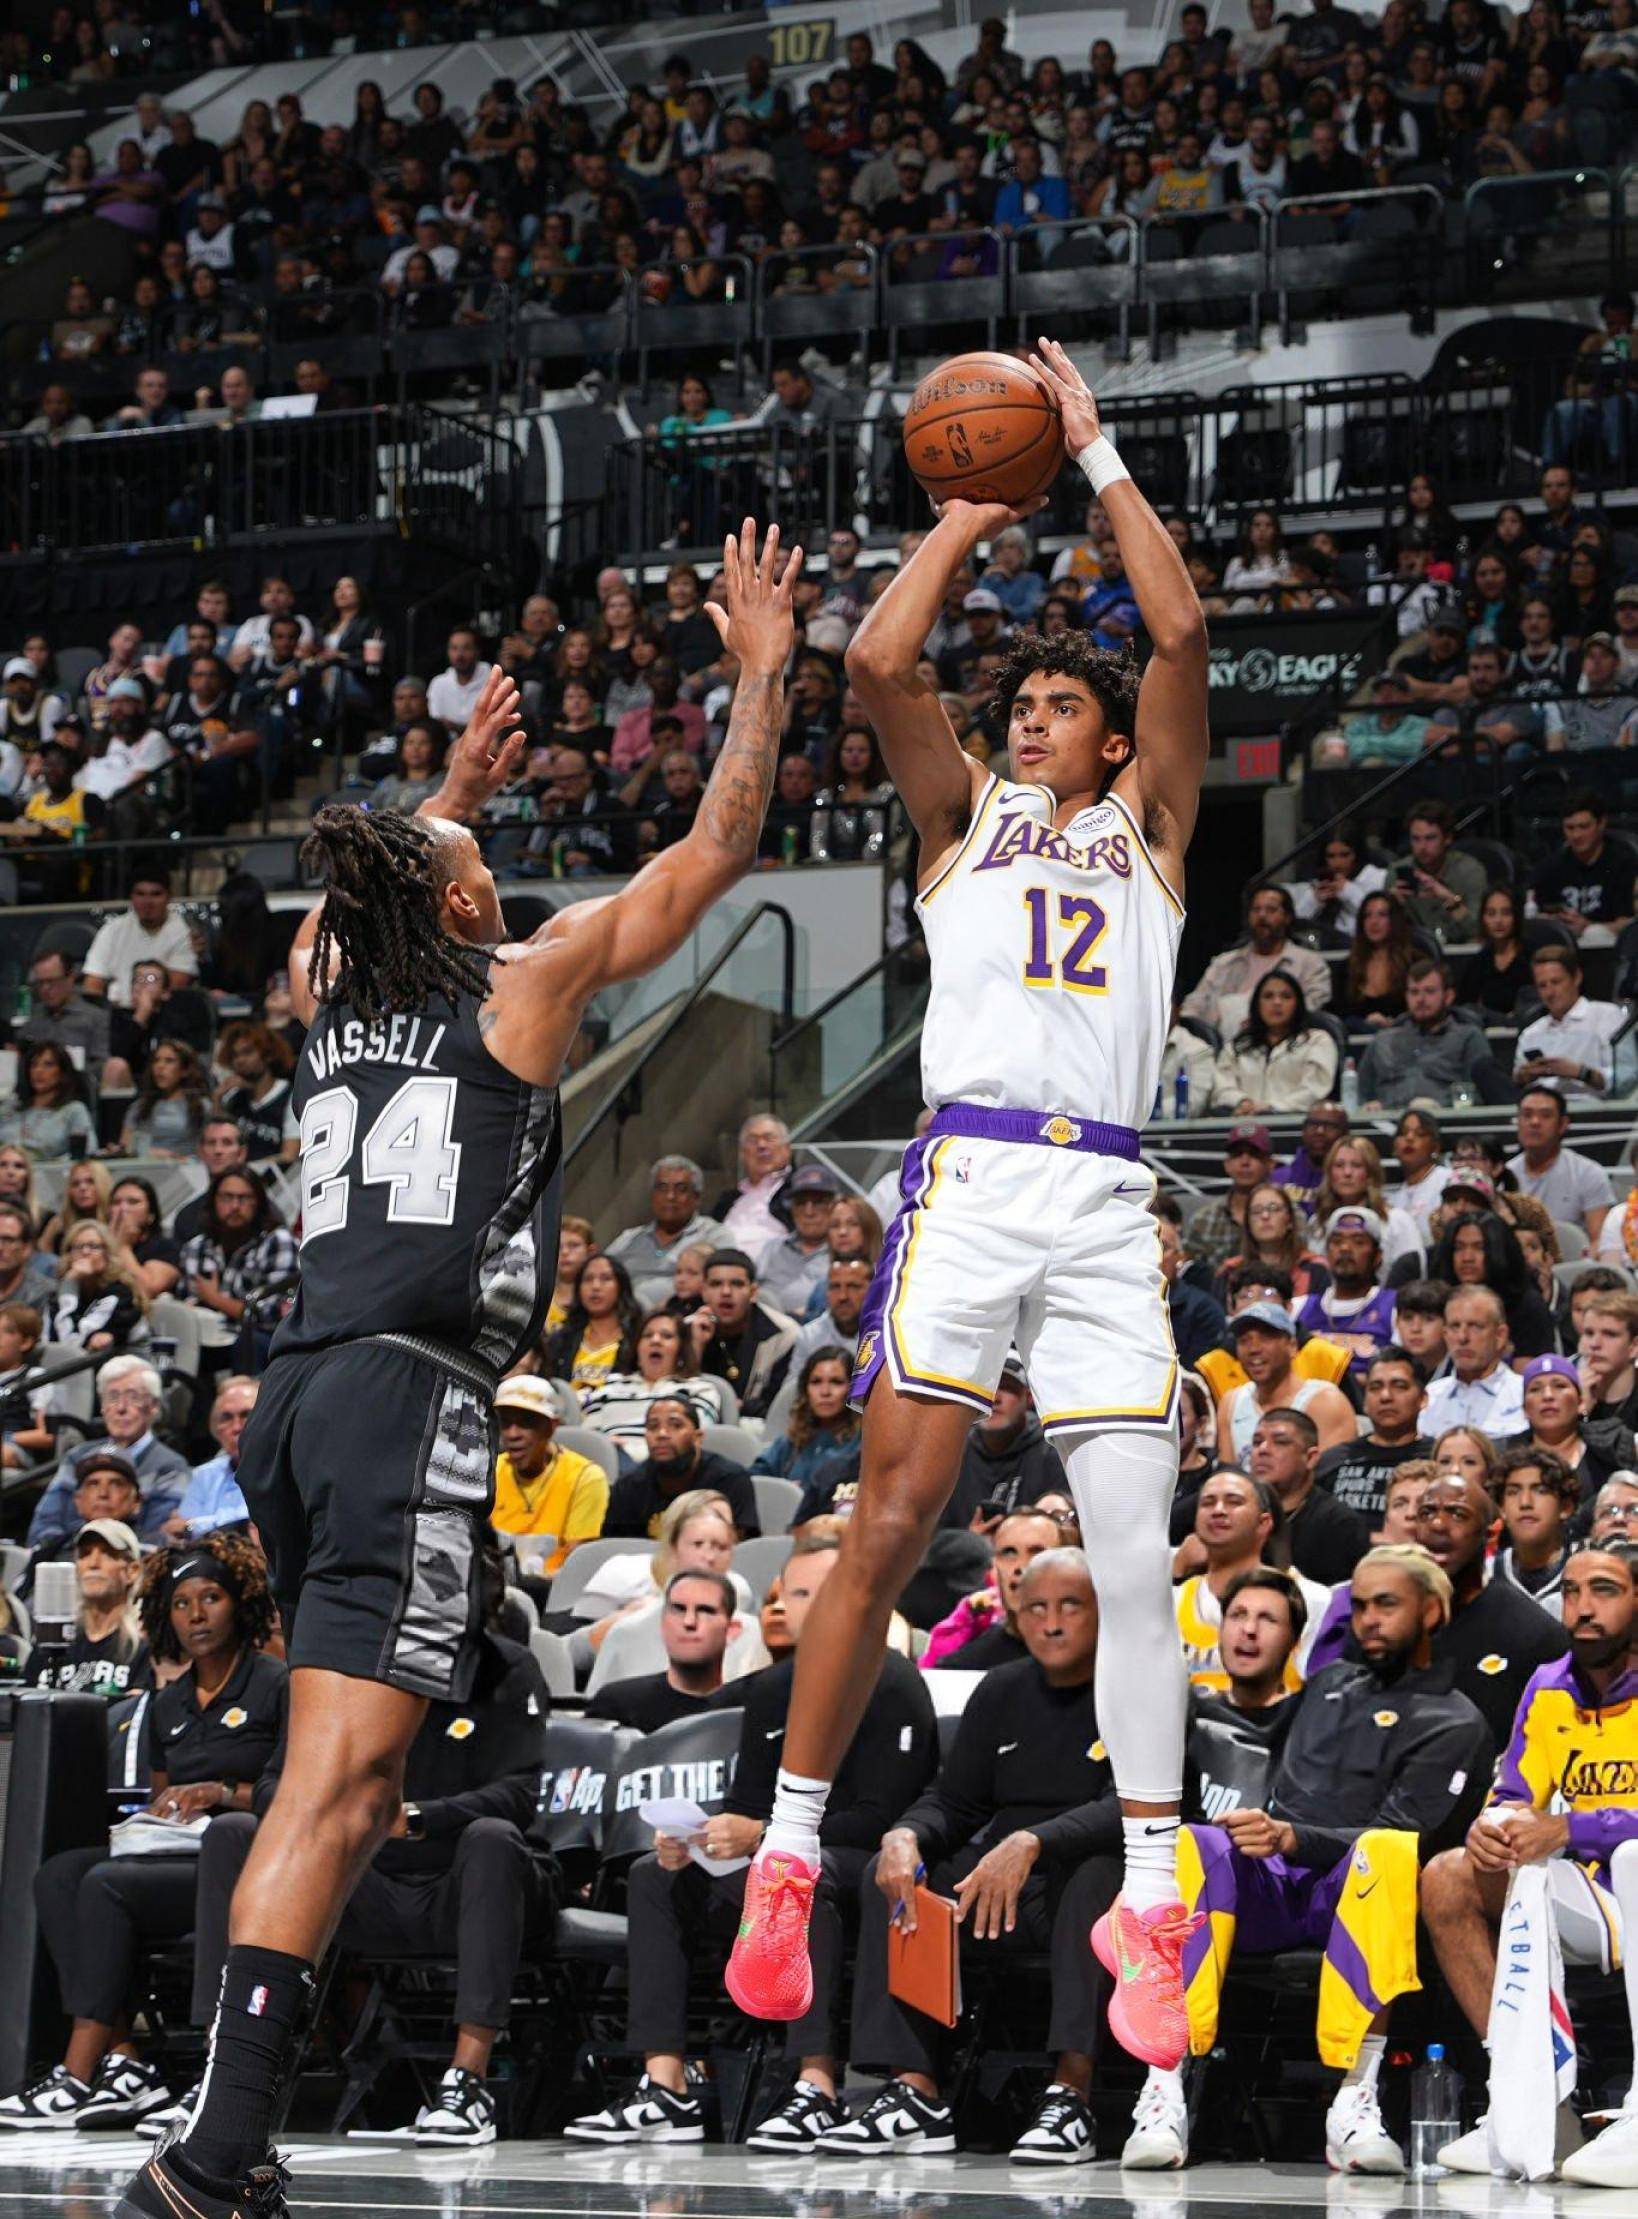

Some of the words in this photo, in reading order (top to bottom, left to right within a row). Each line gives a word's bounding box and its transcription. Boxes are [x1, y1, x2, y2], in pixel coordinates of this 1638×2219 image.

[768, 23, 833, 66] 107
[911, 375, 1008, 416] Wilson
[971, 811, 1132, 881] LAKERS
[1023, 886, 1111, 997] 12
[307, 1014, 446, 1081] VASSELL
[299, 1076, 462, 1250] 24
[616, 1766, 665, 1812] GET
[670, 1760, 725, 1802] THE
